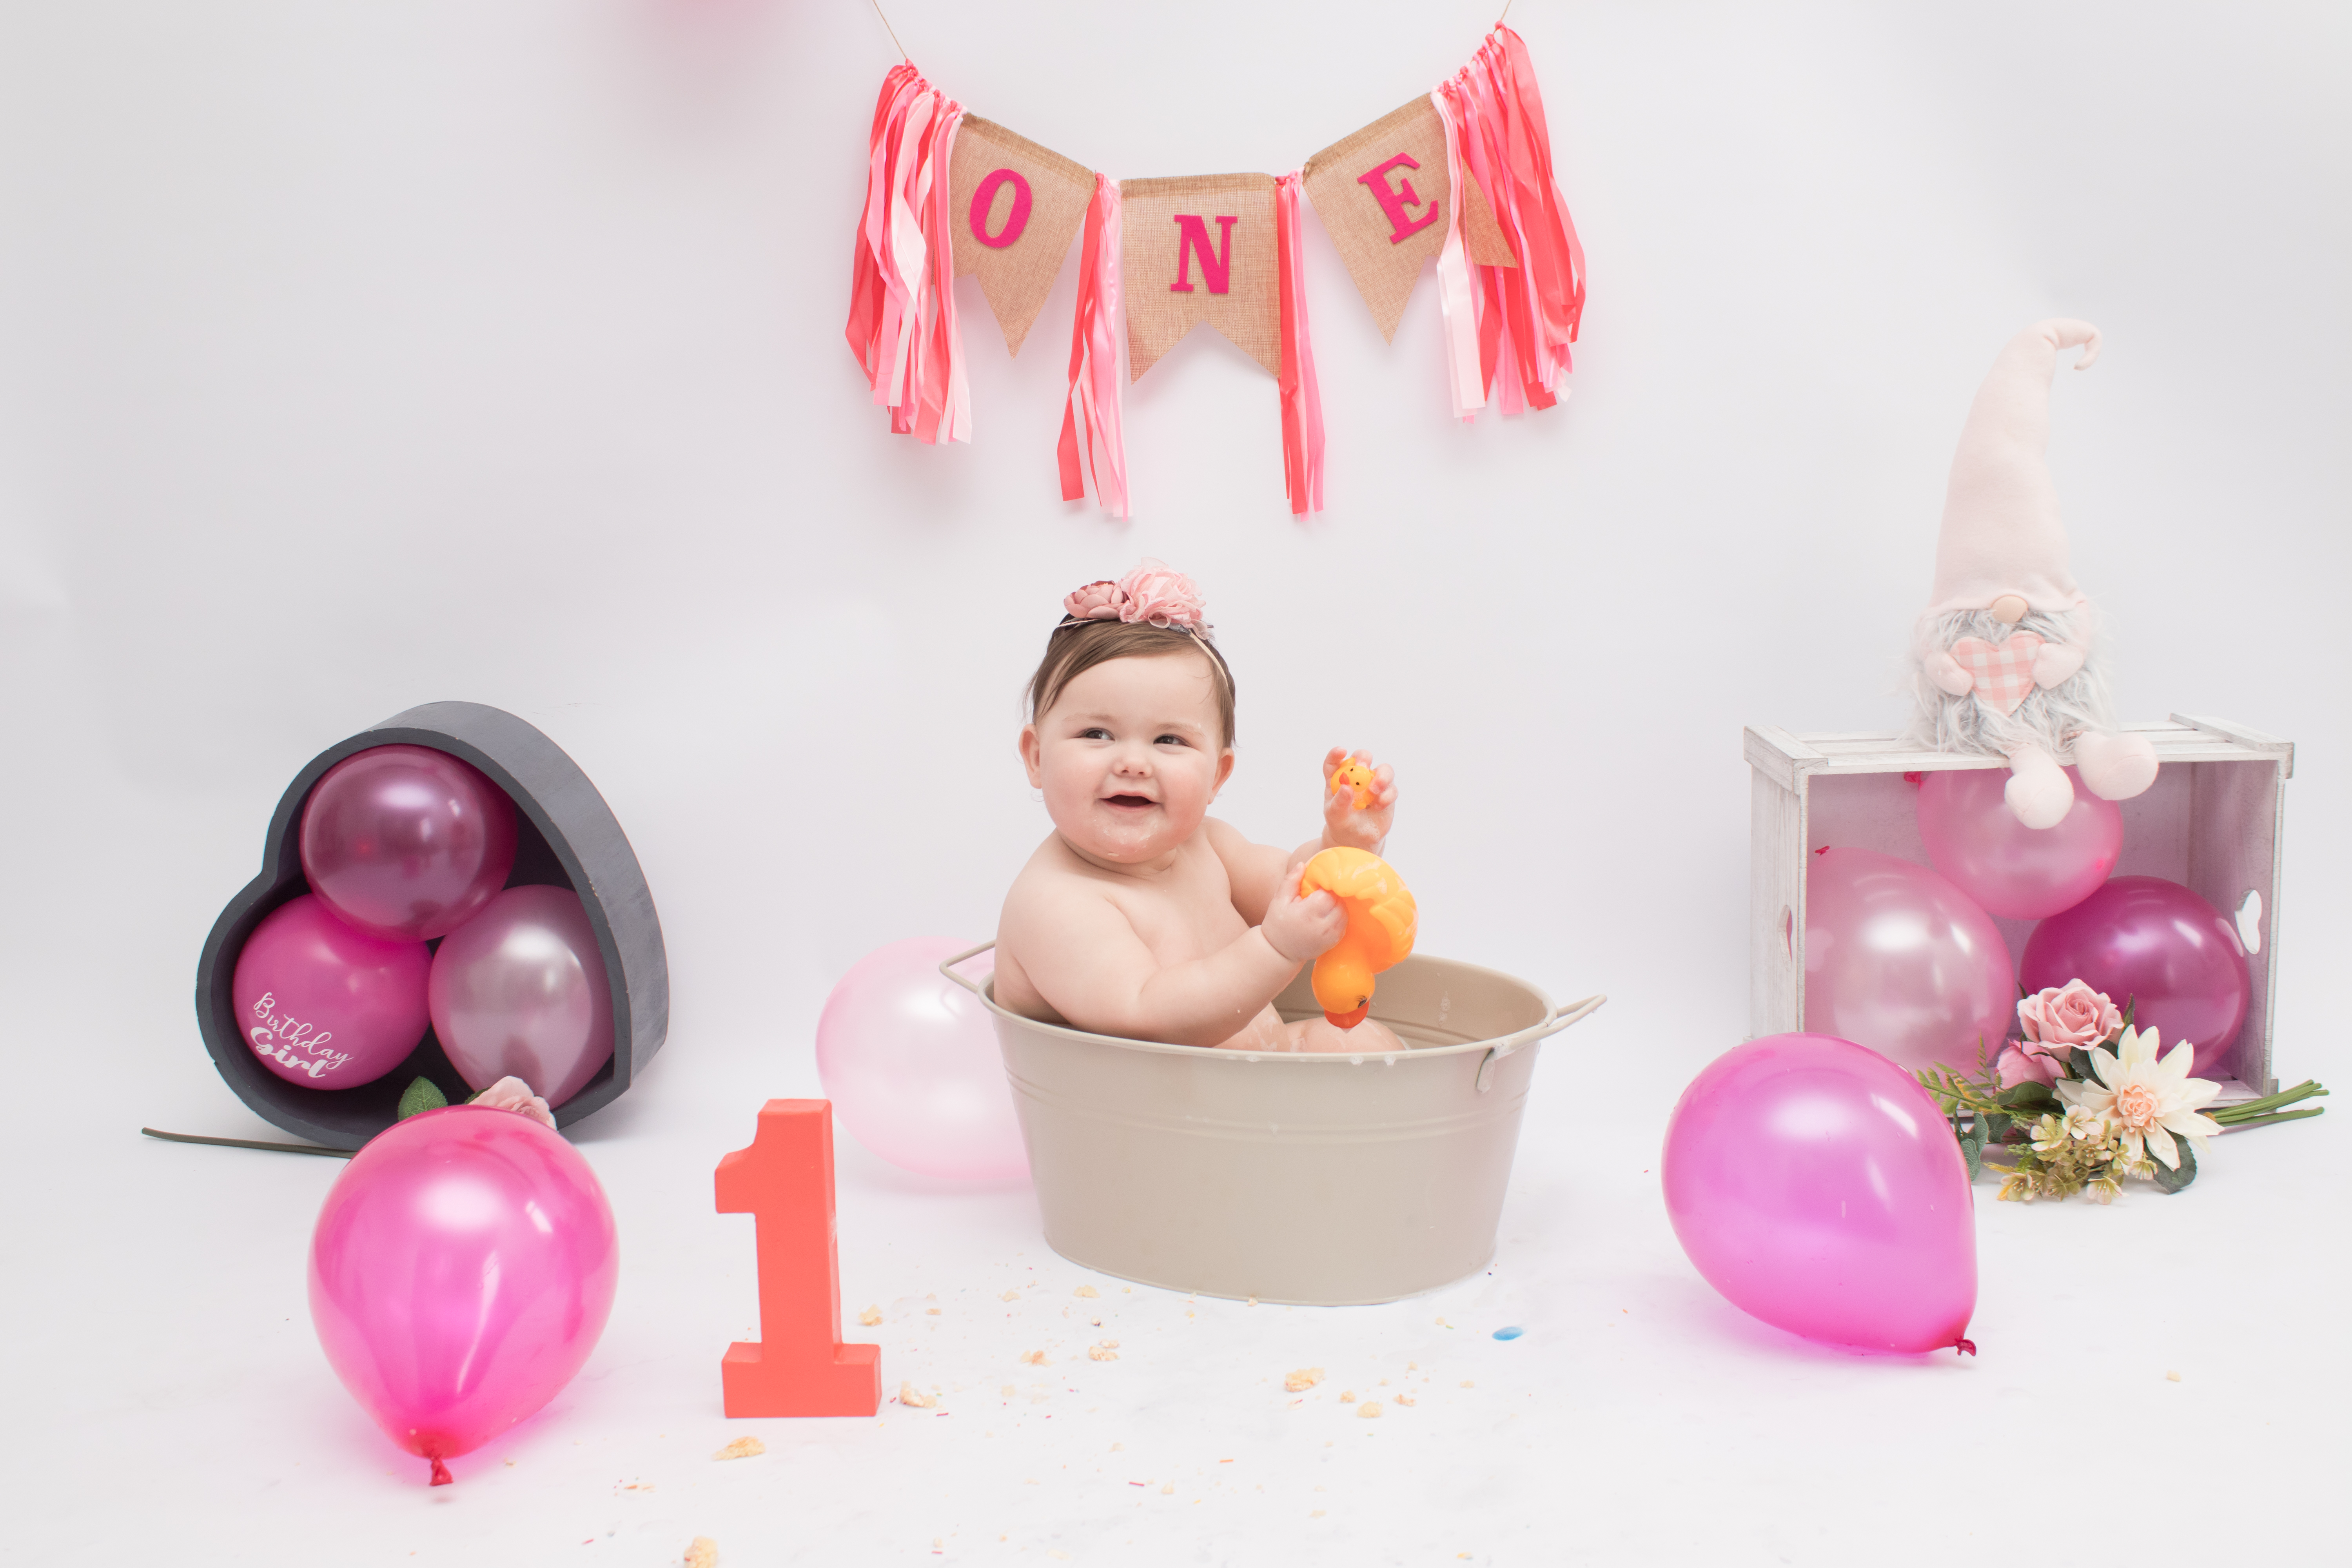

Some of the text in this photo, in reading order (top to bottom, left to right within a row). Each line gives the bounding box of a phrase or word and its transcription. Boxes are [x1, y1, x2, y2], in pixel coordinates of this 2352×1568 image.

[250, 1027, 326, 1078] Girl
[253, 992, 354, 1069] Birthday
[714, 1098, 882, 1418] 1
